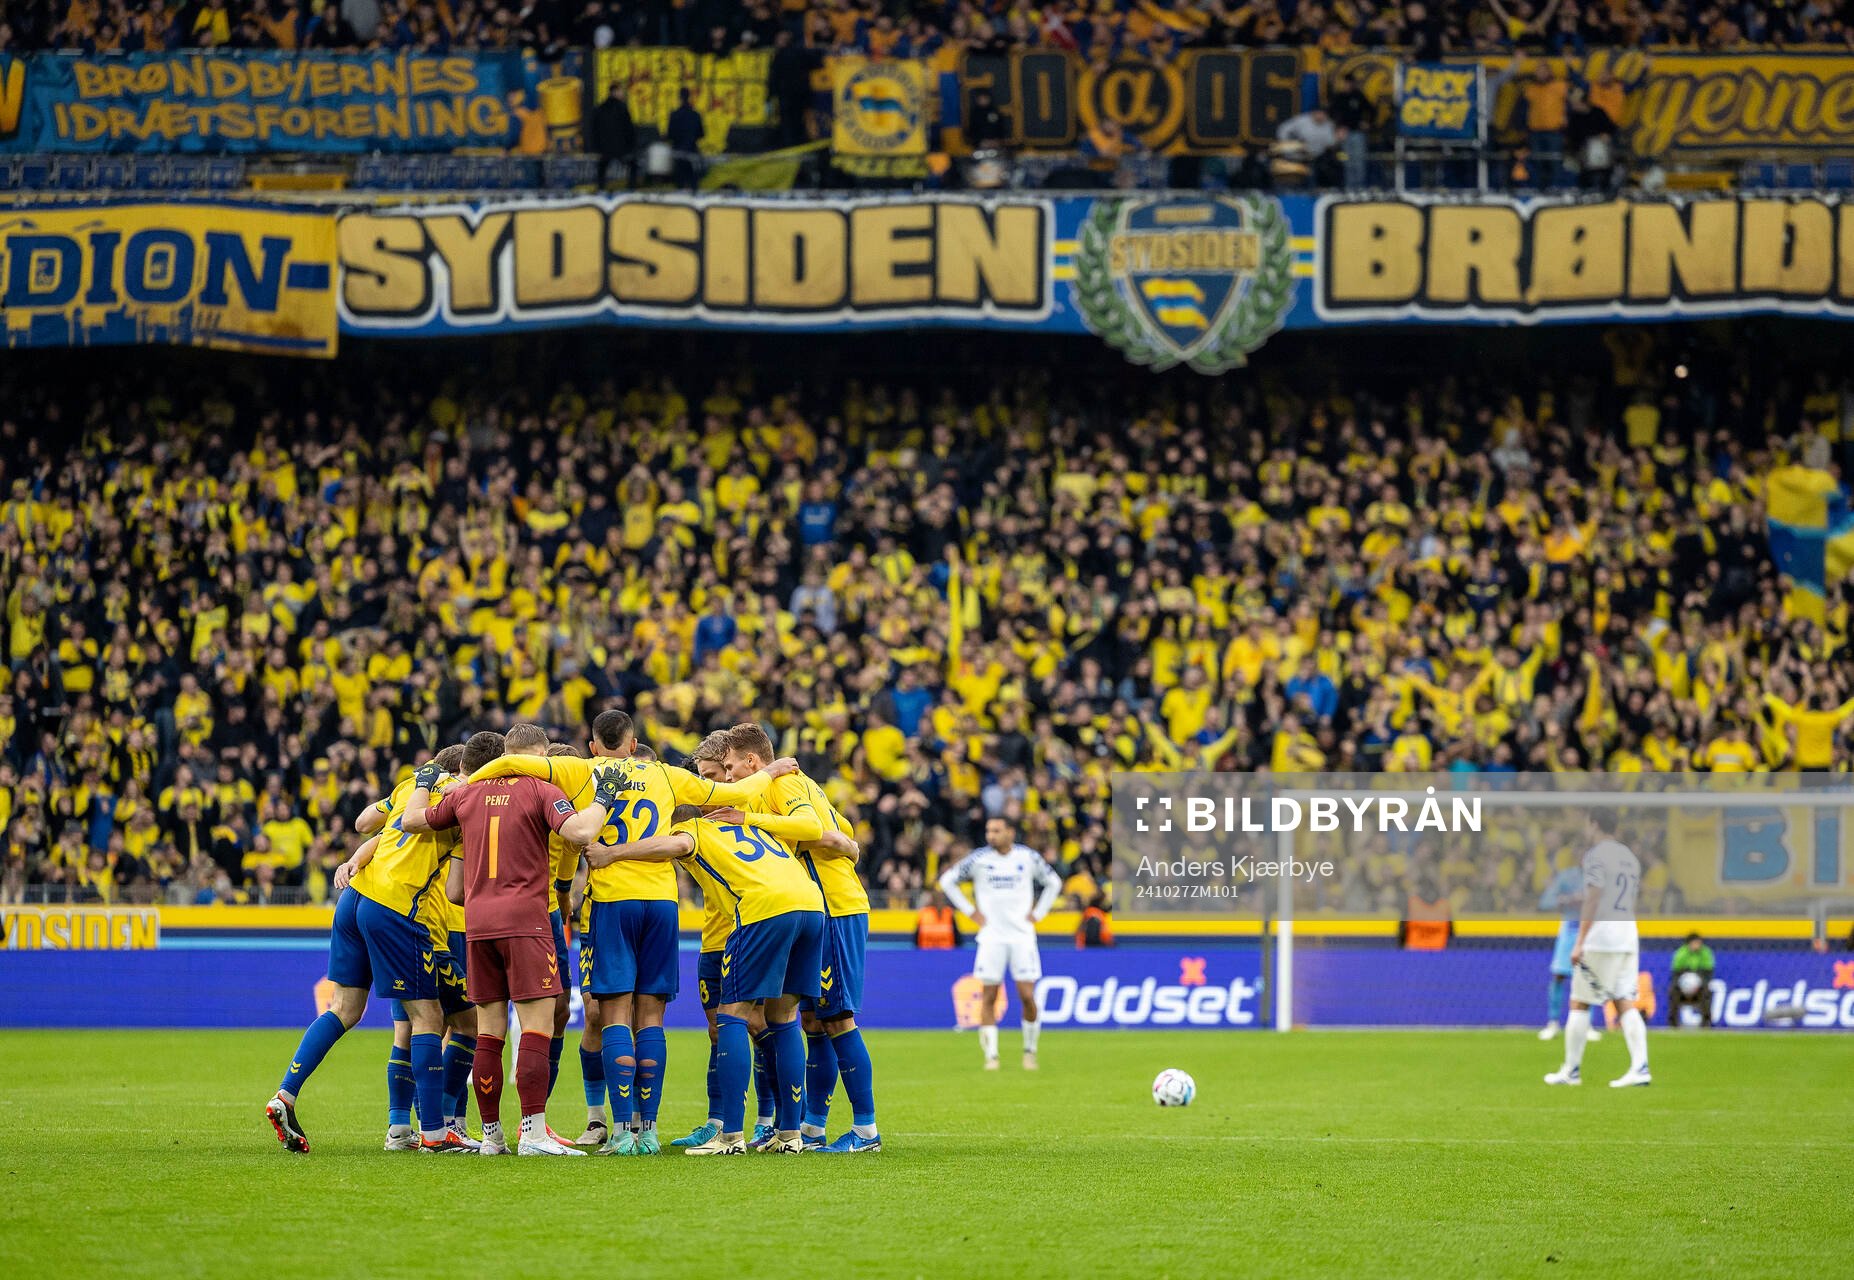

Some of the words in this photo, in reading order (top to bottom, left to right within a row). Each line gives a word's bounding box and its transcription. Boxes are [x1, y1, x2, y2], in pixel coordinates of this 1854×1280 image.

[75, 57, 479, 99] BRØNDBYERNES
[55, 96, 510, 142] IDRÆTSFORENING
[338, 200, 1044, 312] SYDSIDEN
[1330, 199, 1854, 308] BRØND
[485, 794, 511, 806] PENTZ
[597, 797, 660, 848] 32
[488, 815, 500, 879] 1
[717, 824, 791, 863] 30
[0, 913, 158, 951] YDSIDEN
[699, 979, 711, 1004] 8
[1038, 975, 1255, 1024] Oddset
